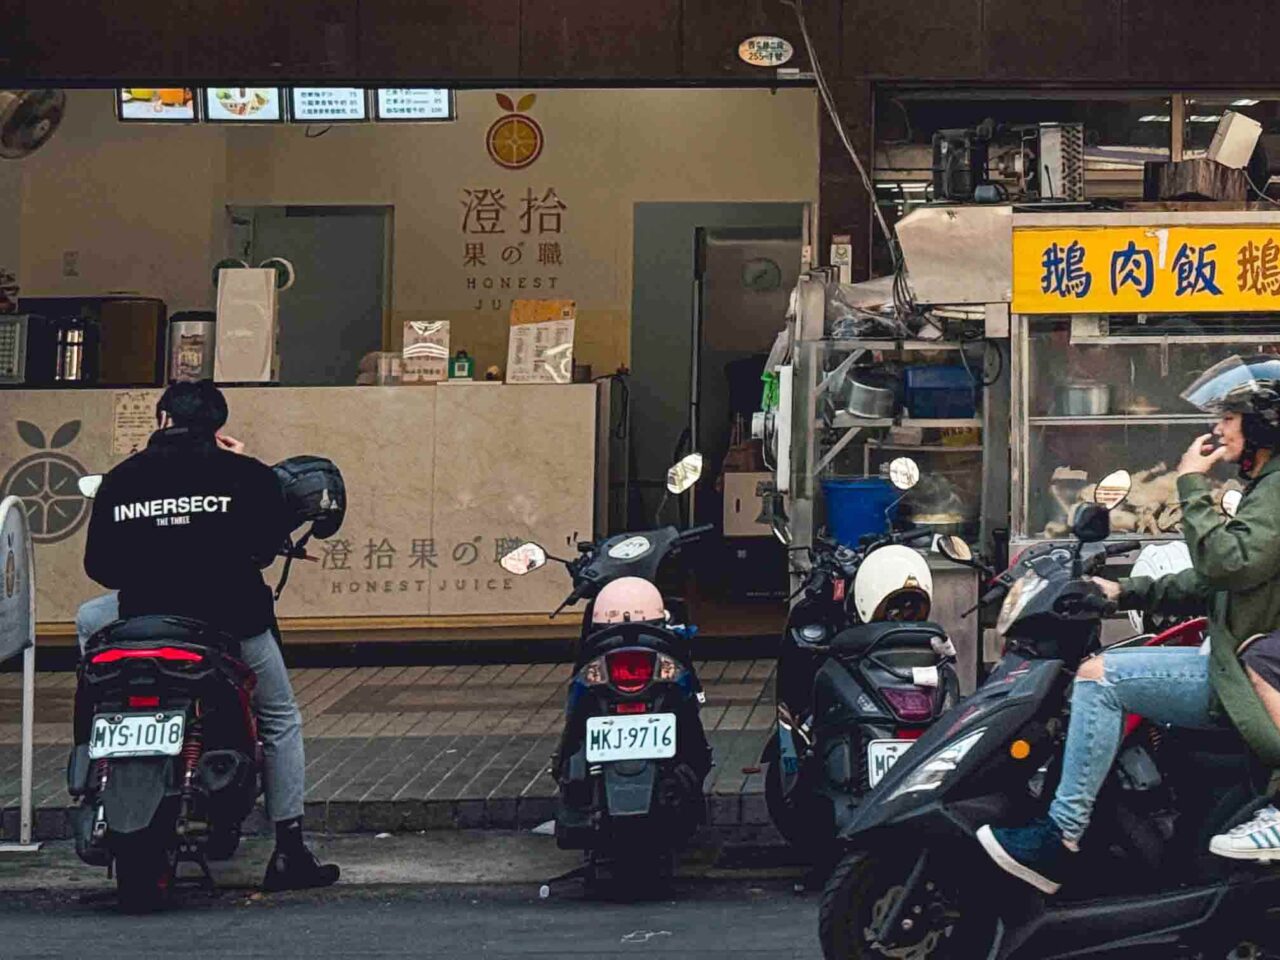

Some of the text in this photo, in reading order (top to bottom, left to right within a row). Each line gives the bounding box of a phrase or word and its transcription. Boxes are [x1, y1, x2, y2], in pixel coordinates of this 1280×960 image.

[460, 187, 567, 234] 澄拾
[1040, 240, 1223, 299] 鵝肉飯
[467, 277, 558, 289] HONEST
[114, 496, 231, 522] INNERSECT
[156, 515, 190, 526] THE THREE
[332, 578, 513, 594] HONEST JUICE
